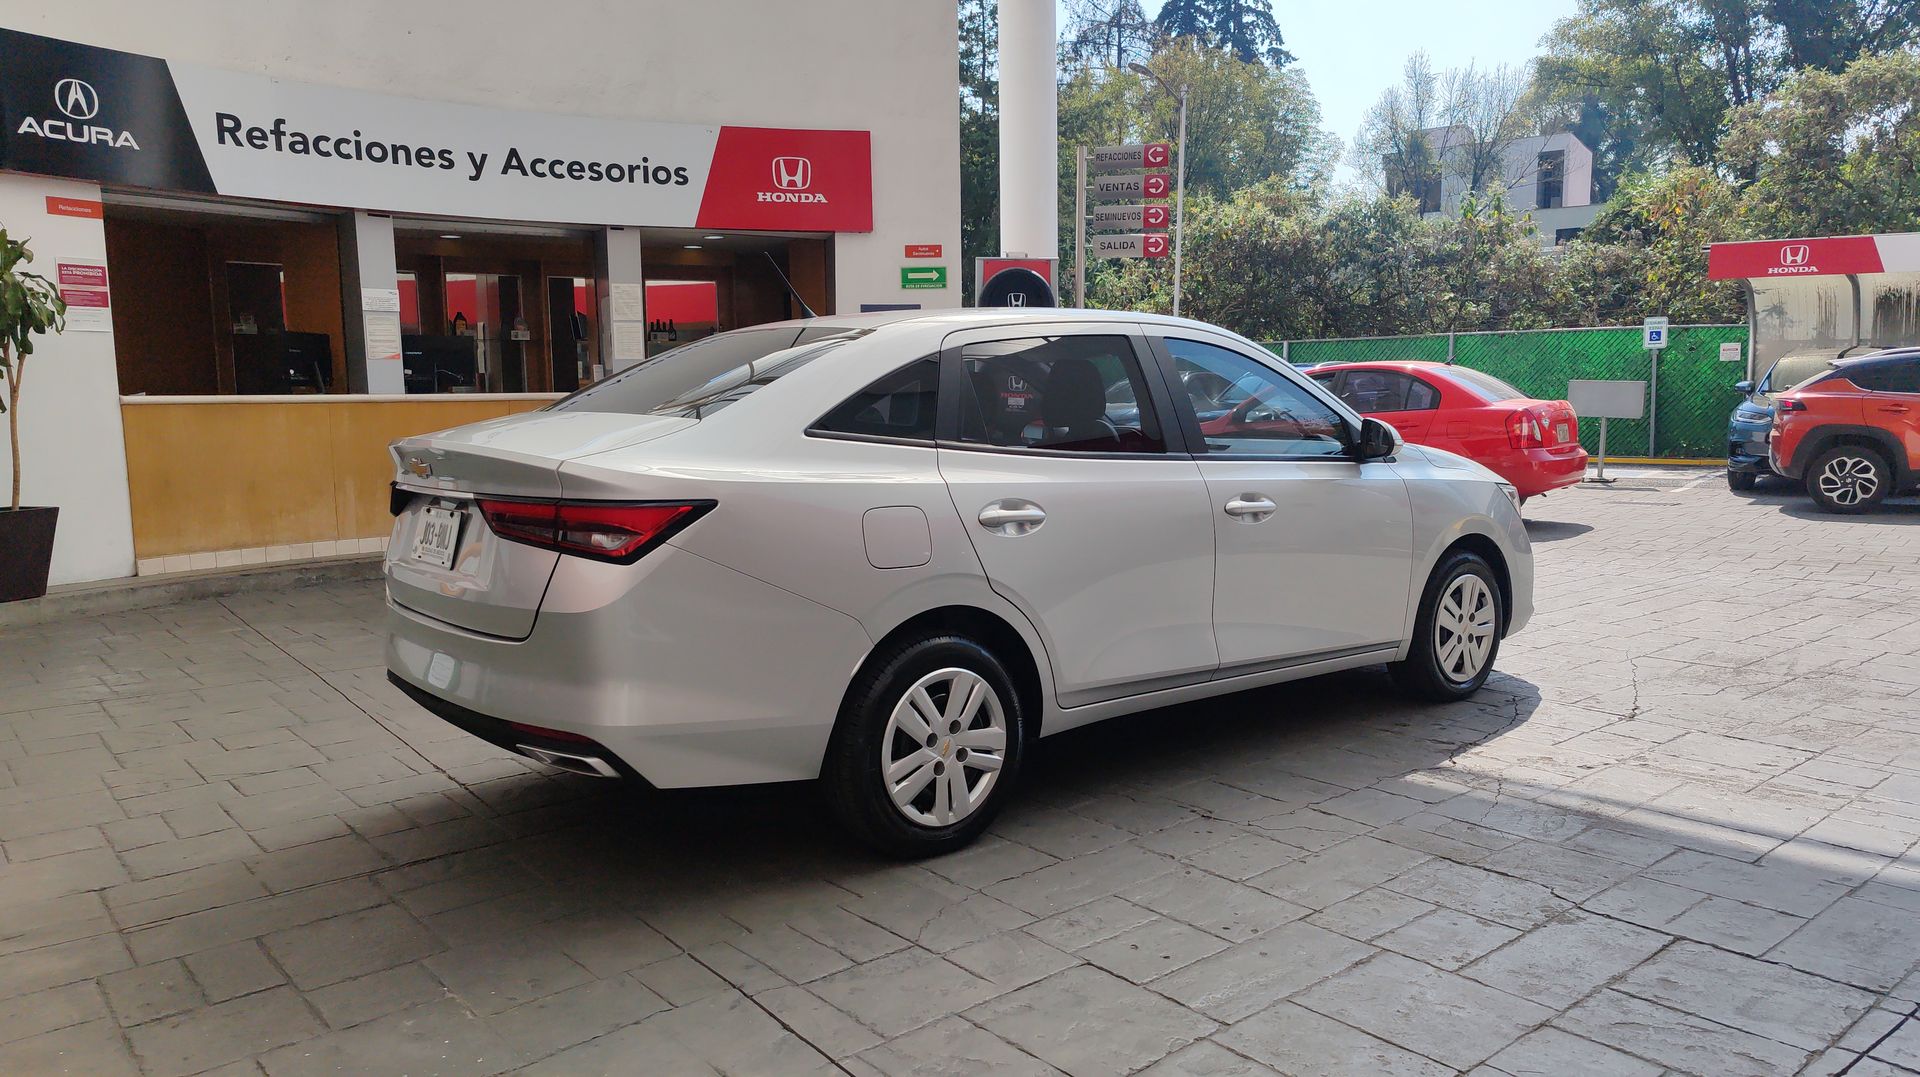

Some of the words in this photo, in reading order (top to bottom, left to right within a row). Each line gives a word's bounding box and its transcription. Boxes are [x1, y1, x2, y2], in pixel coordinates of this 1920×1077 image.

[17, 116, 141, 151] ACURA
[215, 111, 456, 170] Refacciones
[466, 151, 489, 182] y
[500, 147, 690, 186] Accesorios
[1095, 151, 1142, 162] REFACCIONES
[1098, 182, 1140, 192] VENTAS
[756, 191, 829, 203] HONDA
[1095, 211, 1142, 222] SEMINUEVOS
[1099, 241, 1136, 250] SALIDA
[1767, 265, 1819, 275] HONDA
